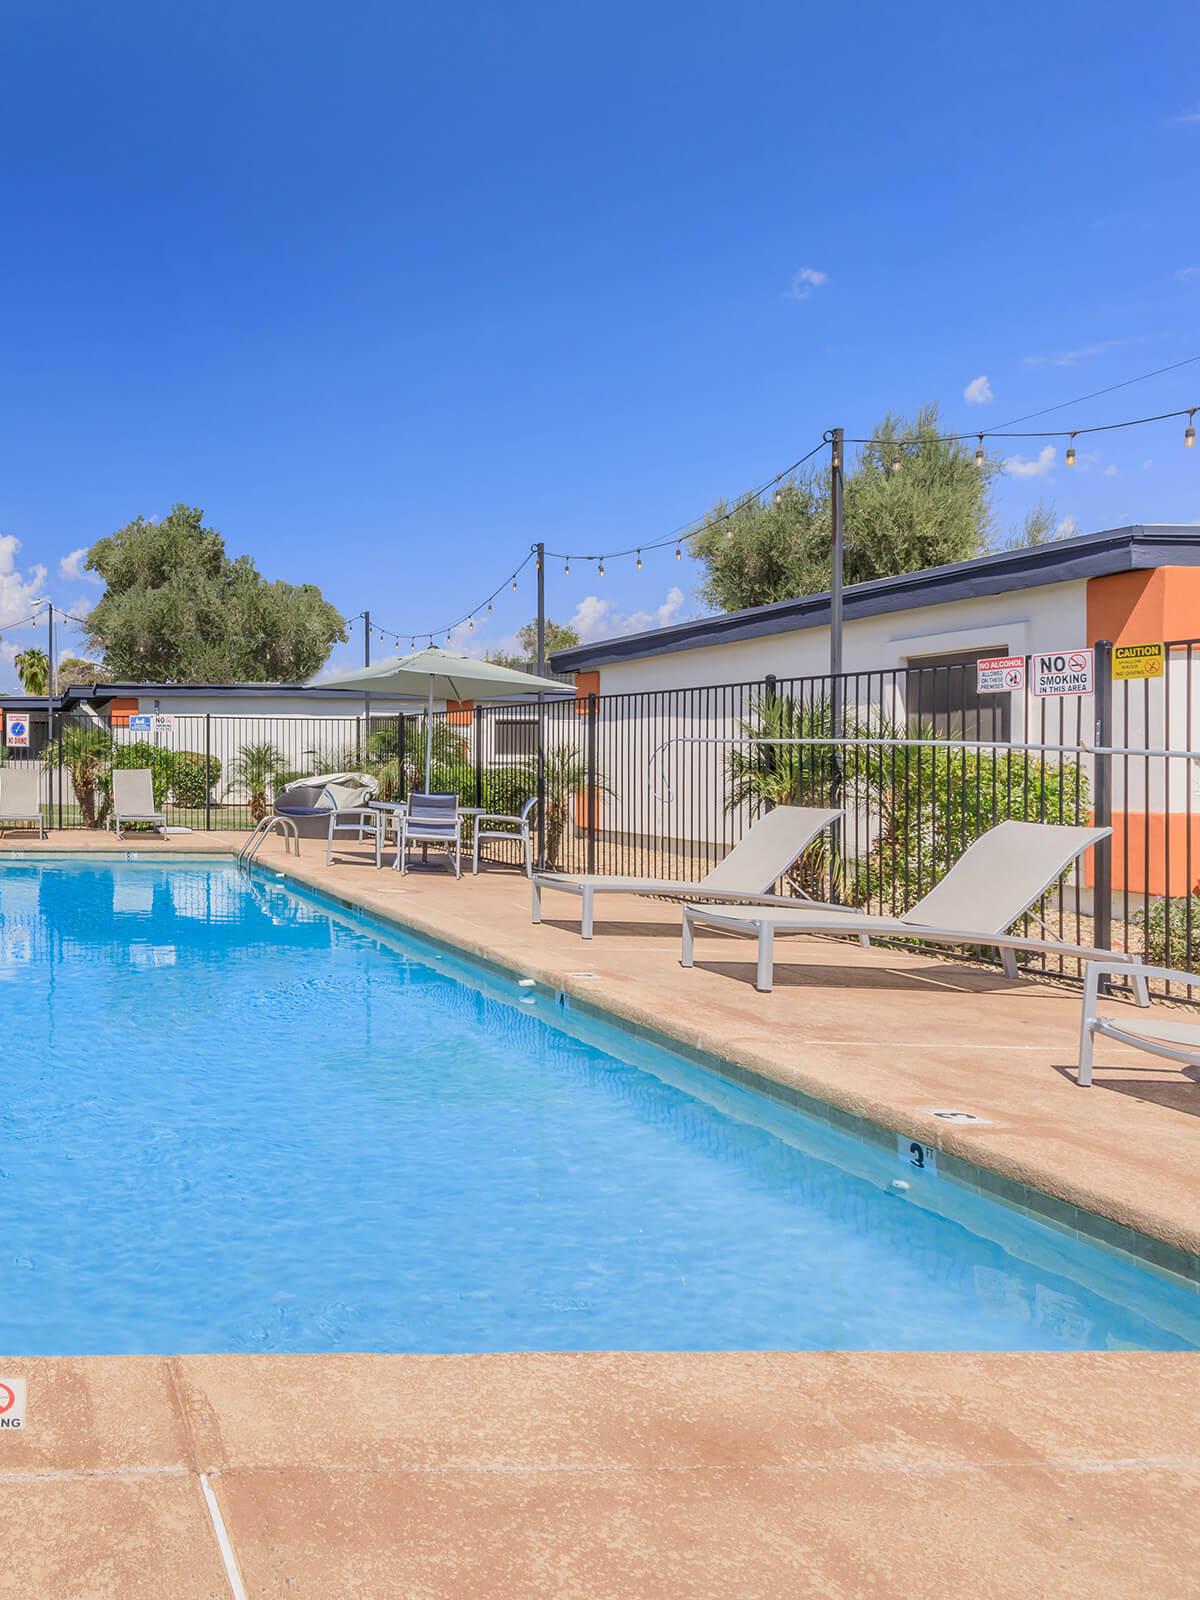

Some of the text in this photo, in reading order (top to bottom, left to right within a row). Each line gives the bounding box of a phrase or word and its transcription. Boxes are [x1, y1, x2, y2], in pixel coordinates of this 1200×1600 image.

[1117, 647, 1159, 657] CAUTION
[990, 659, 1023, 668] ALCOHOL
[1040, 656, 1065, 673] NO
[1040, 674, 1087, 685] SMOKING
